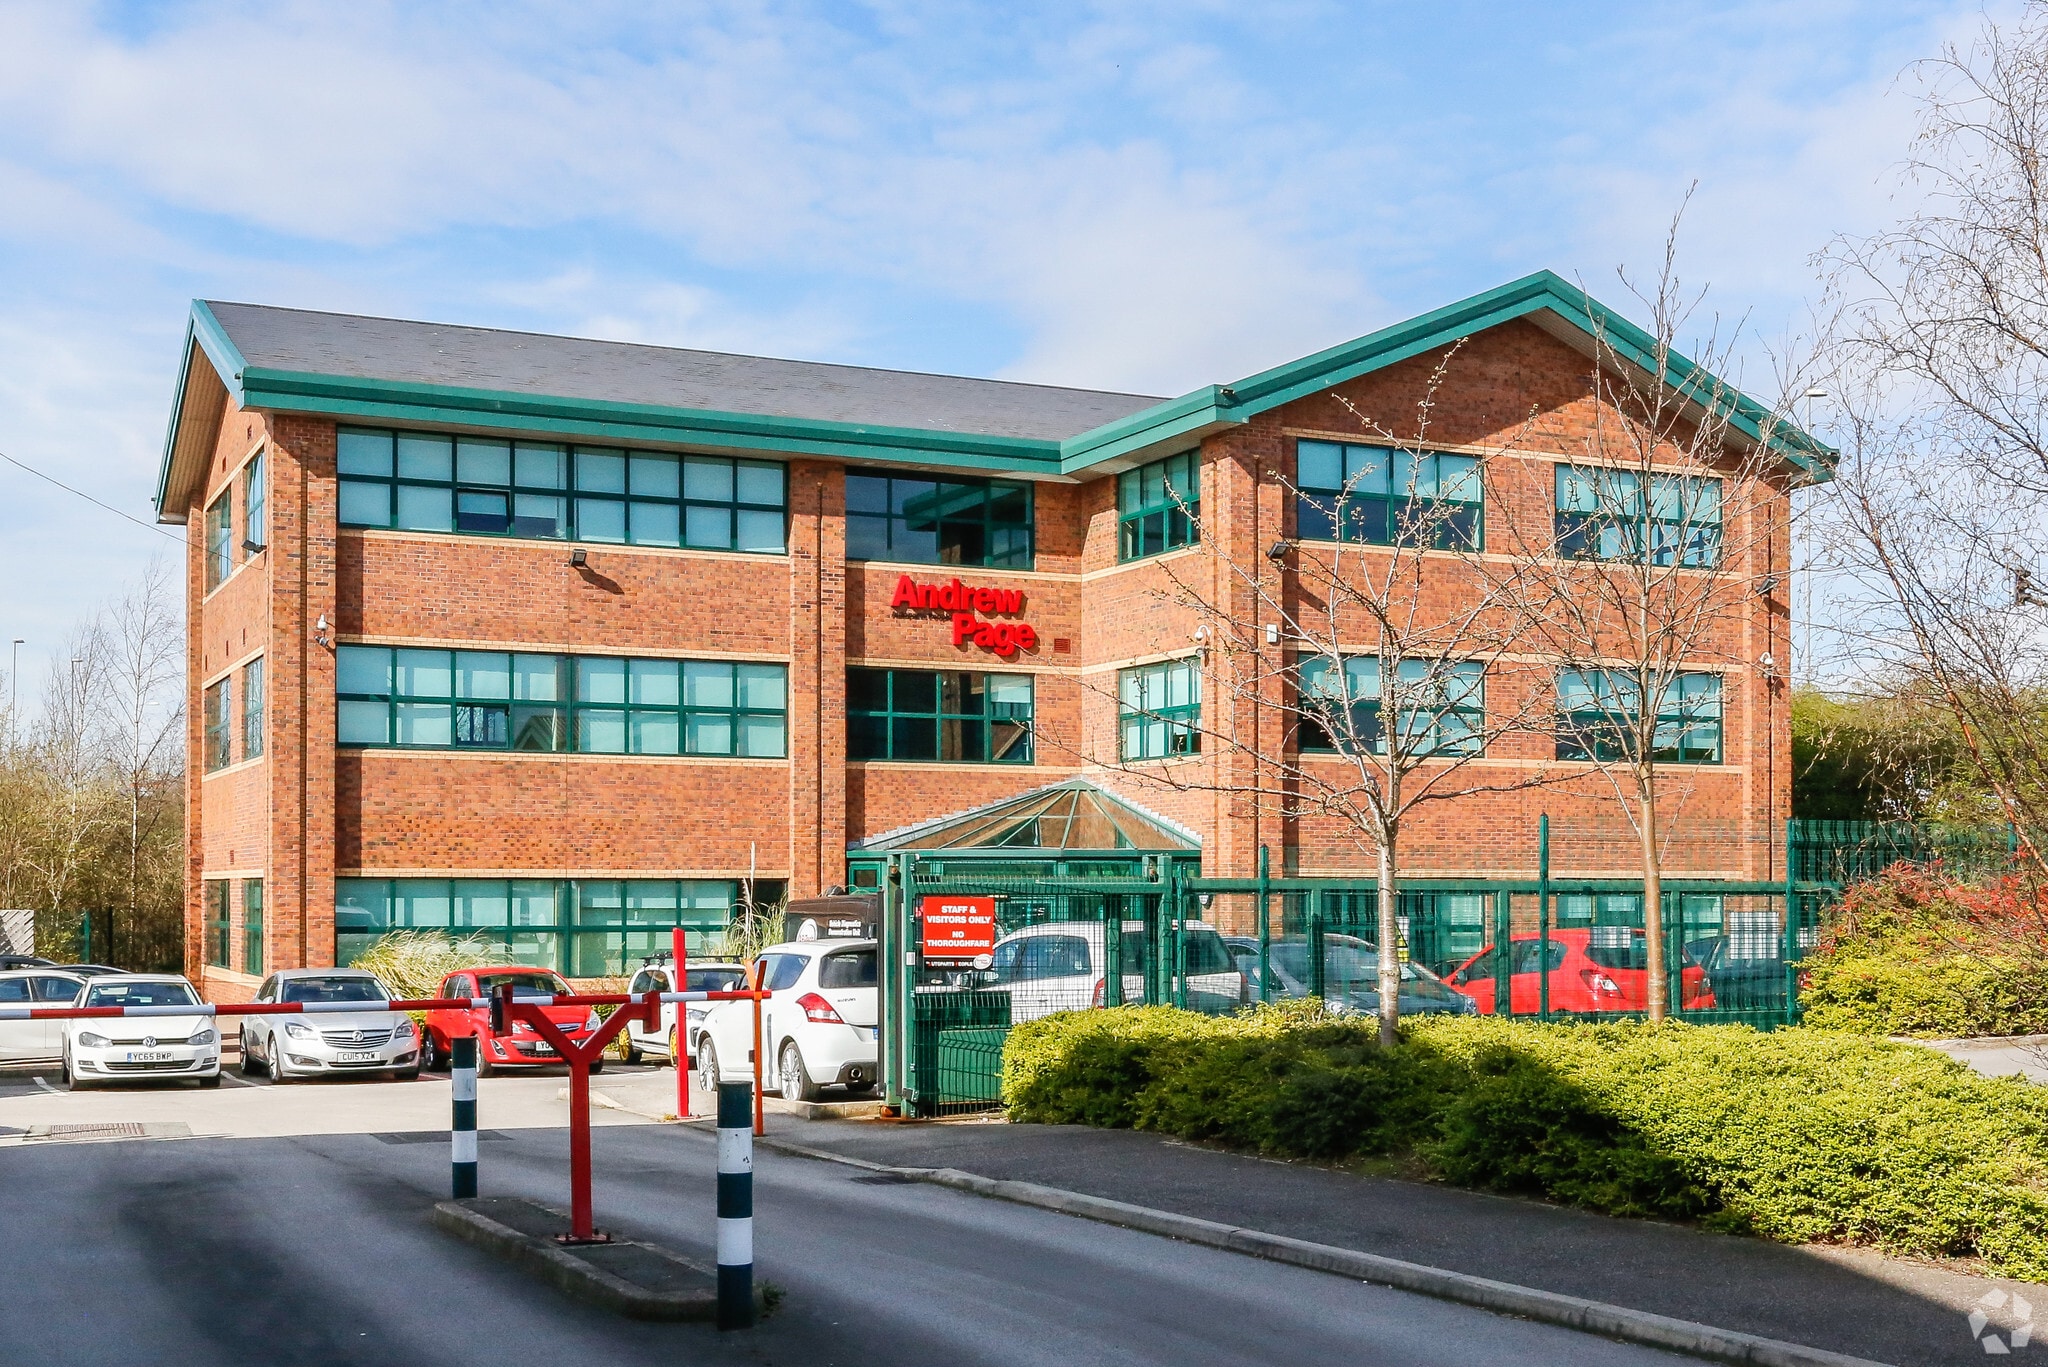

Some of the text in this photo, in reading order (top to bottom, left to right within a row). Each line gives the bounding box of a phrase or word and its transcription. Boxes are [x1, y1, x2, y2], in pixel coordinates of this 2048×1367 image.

[891, 575, 1023, 613] Andrew
[952, 613, 1035, 657] Page
[941, 905, 977, 914] STAFF &
[926, 915, 991, 924] VISITORS ONLY
[133, 1052, 154, 1061] YC65
[342, 1053, 359, 1061] CU15
